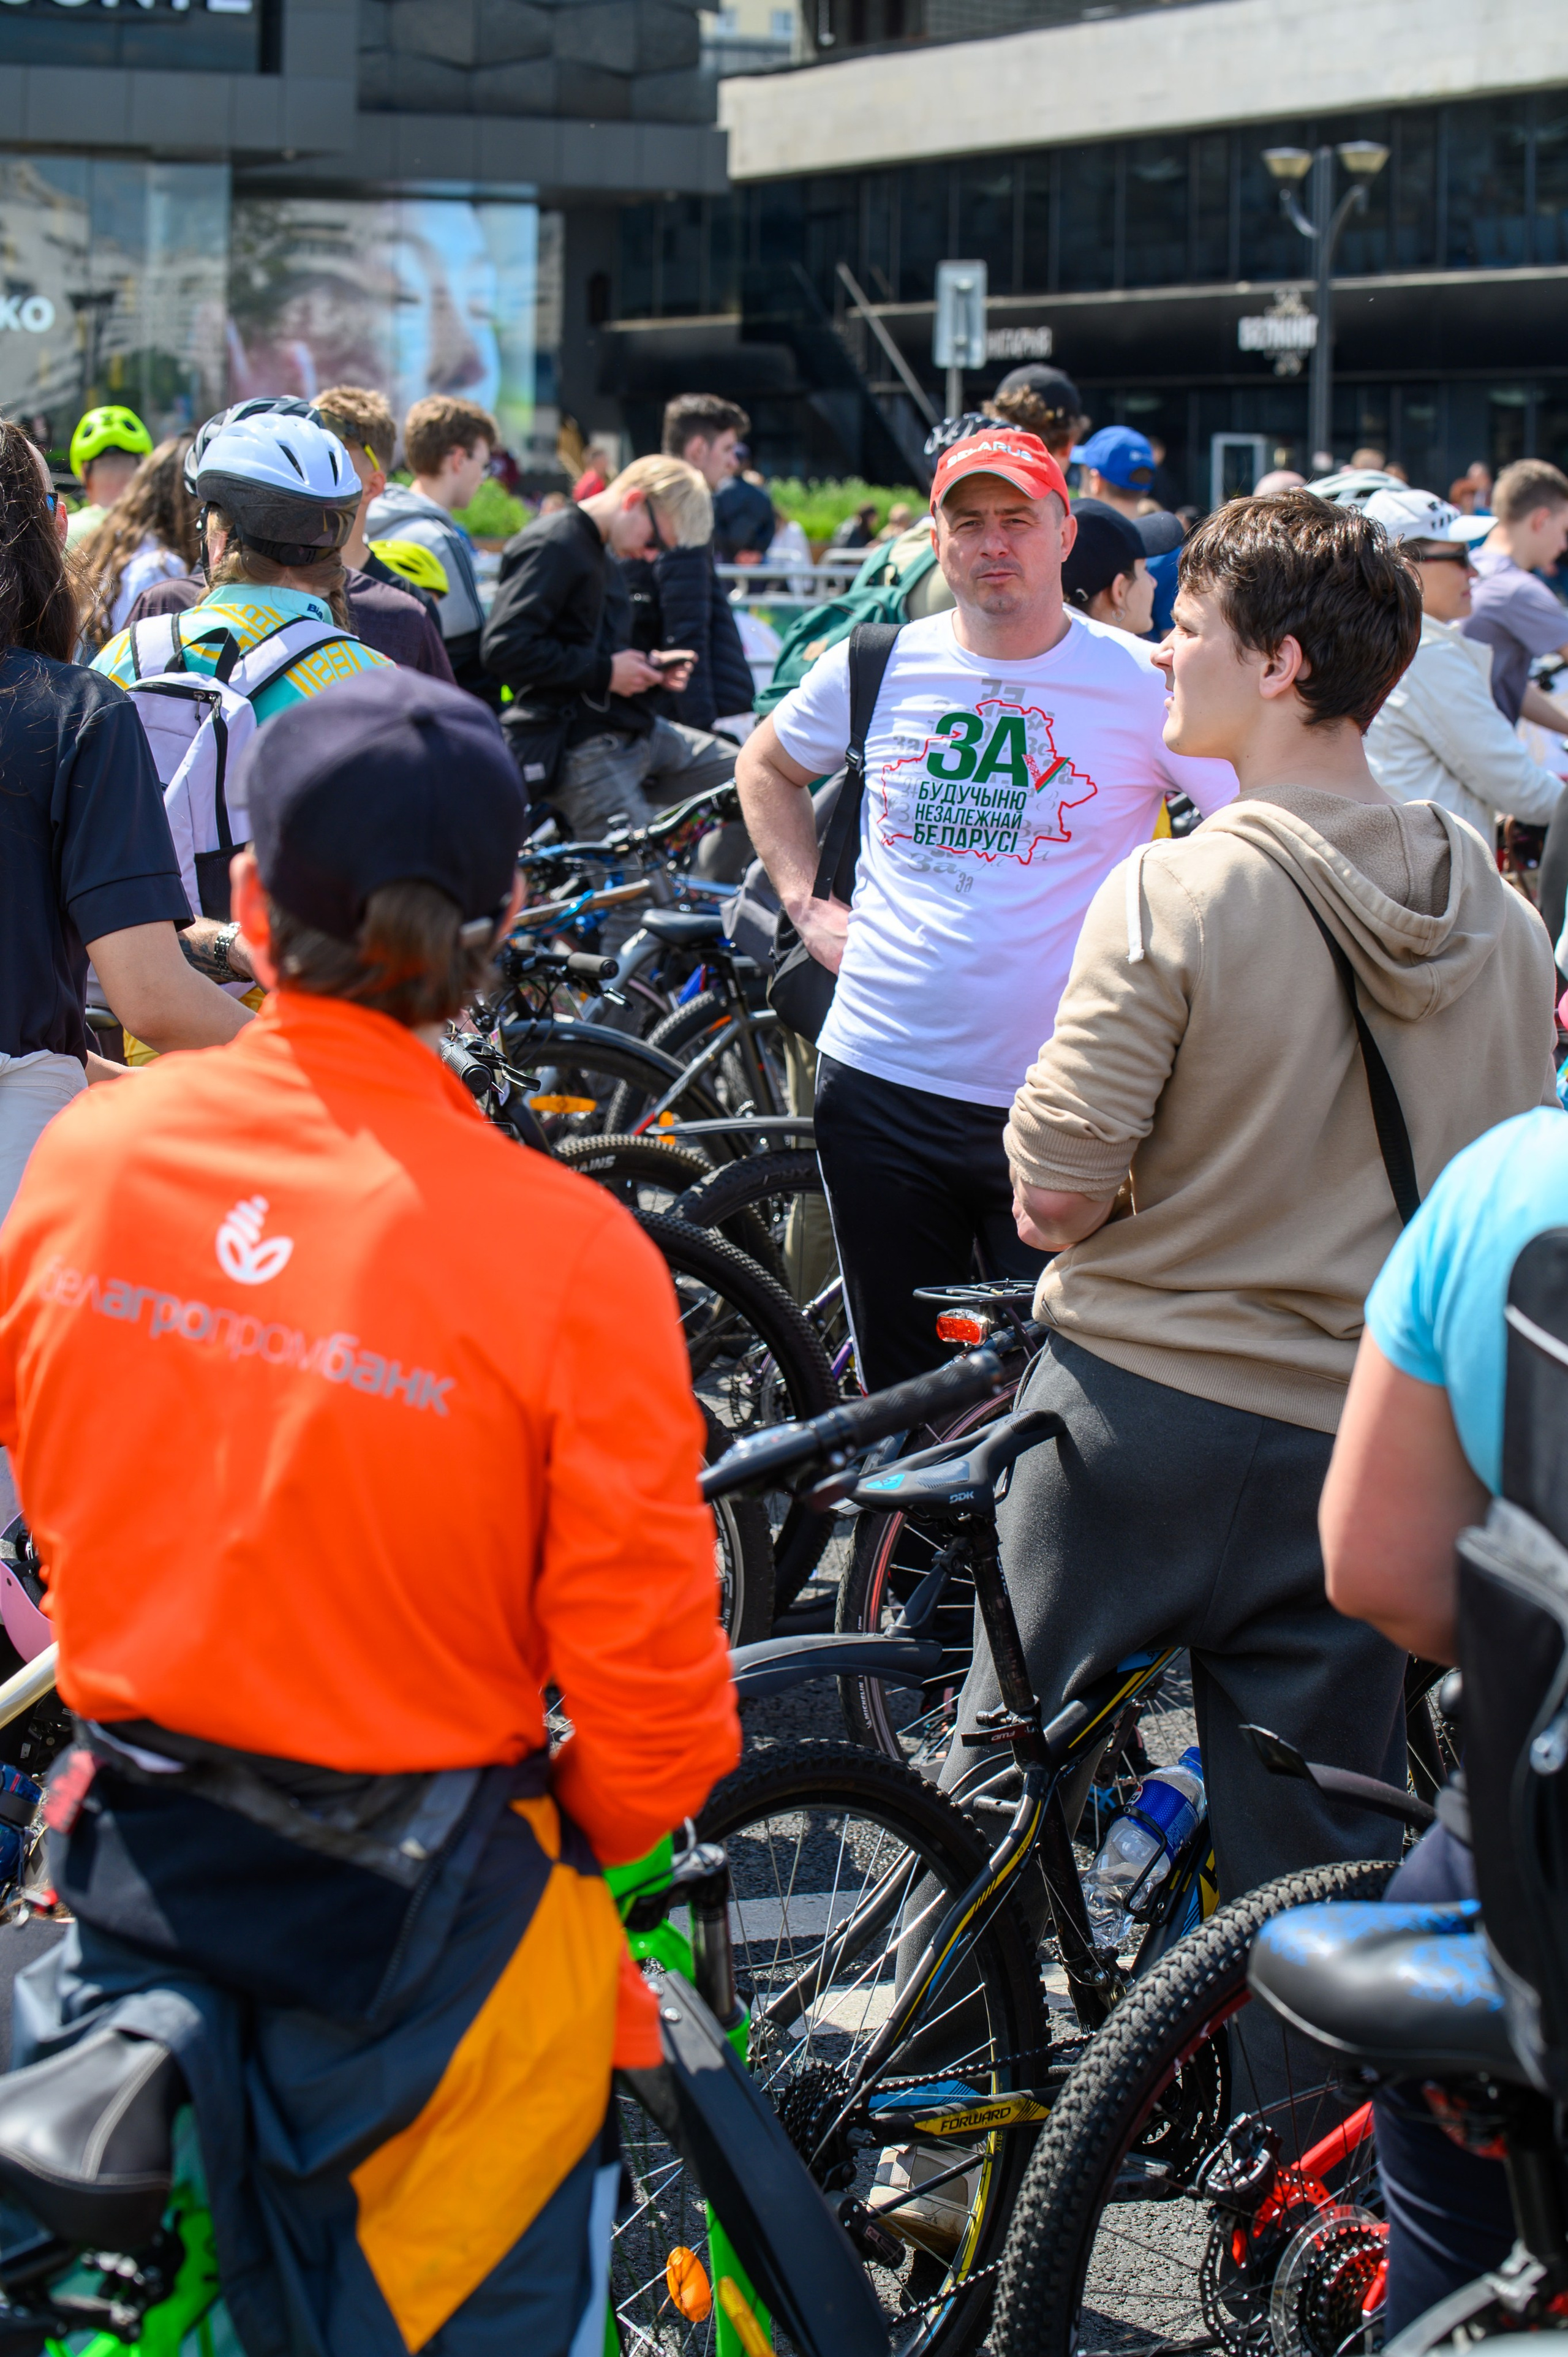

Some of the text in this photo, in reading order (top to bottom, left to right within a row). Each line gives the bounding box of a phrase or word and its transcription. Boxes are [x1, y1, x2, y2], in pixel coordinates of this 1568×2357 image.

[946, 441, 1033, 469] BELARUS
[307, 603, 325, 622] Bia
[927, 712, 1029, 788] ЗА
[918, 781, 1027, 811] БУДУЧЫНЮ
[914, 803, 1023, 830] НЕЗАЛЕЖНАЙ
[913, 823, 1019, 853] БЕЛАРУСІ
[38, 1253, 457, 1417] белагропромбанк
[949, 1490, 974, 1504] DDK
[859, 1681, 870, 1720] MICHELIN
[940, 2107, 1011, 2133] FORWARD
